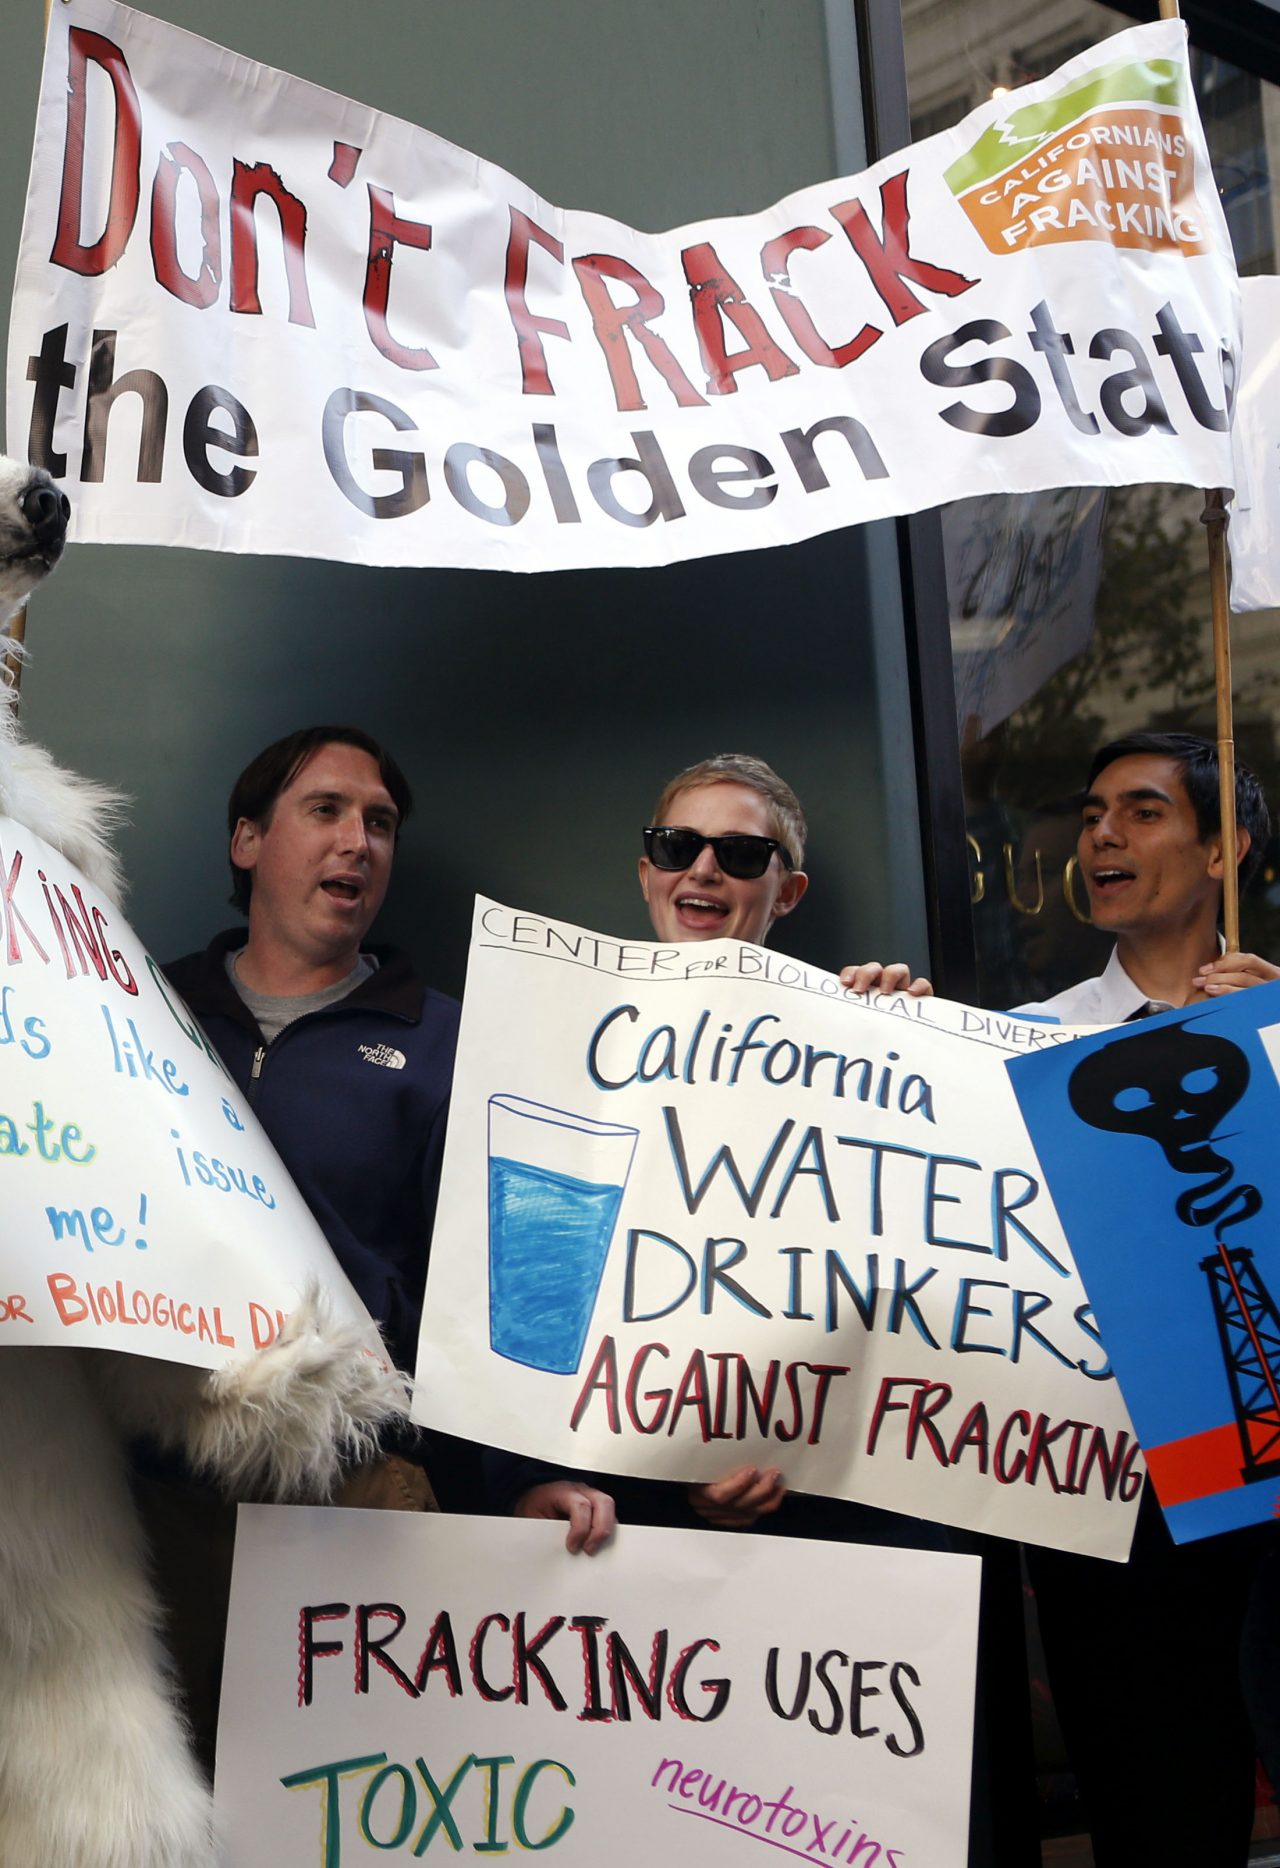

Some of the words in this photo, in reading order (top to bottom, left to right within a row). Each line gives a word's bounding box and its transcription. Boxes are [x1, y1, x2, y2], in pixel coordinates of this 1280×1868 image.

[979, 126, 1185, 205] CALIFORNIANS
[1011, 158, 1176, 218] AGAINST
[50, 26, 441, 371] Don't
[504, 168, 981, 412] FRACK
[1001, 198, 1204, 246] FRACKING
[26, 322, 259, 498] the
[321, 387, 890, 528] Golden
[481, 908, 680, 974] CENTER
[686, 956, 727, 980] FOR
[100, 1004, 189, 1097] like
[357, 1044, 392, 1061] NORTH
[363, 1054, 389, 1067] FACE
[376, 1043, 395, 1055] THE
[586, 1004, 936, 1124] California
[170, 1129, 276, 1210] issue
[662, 1105, 1071, 1278] WATER
[45, 1193, 148, 1252] me!
[46, 1272, 235, 1348] BIOLOGICAL
[623, 1229, 1116, 1381] DRINKERS
[570, 1334, 850, 1446] AGAINST
[866, 1377, 1143, 1502] FRACKING
[297, 1602, 732, 1723] FRACKING
[765, 1647, 925, 1759] USES
[279, 1752, 576, 1868] TOXIC
